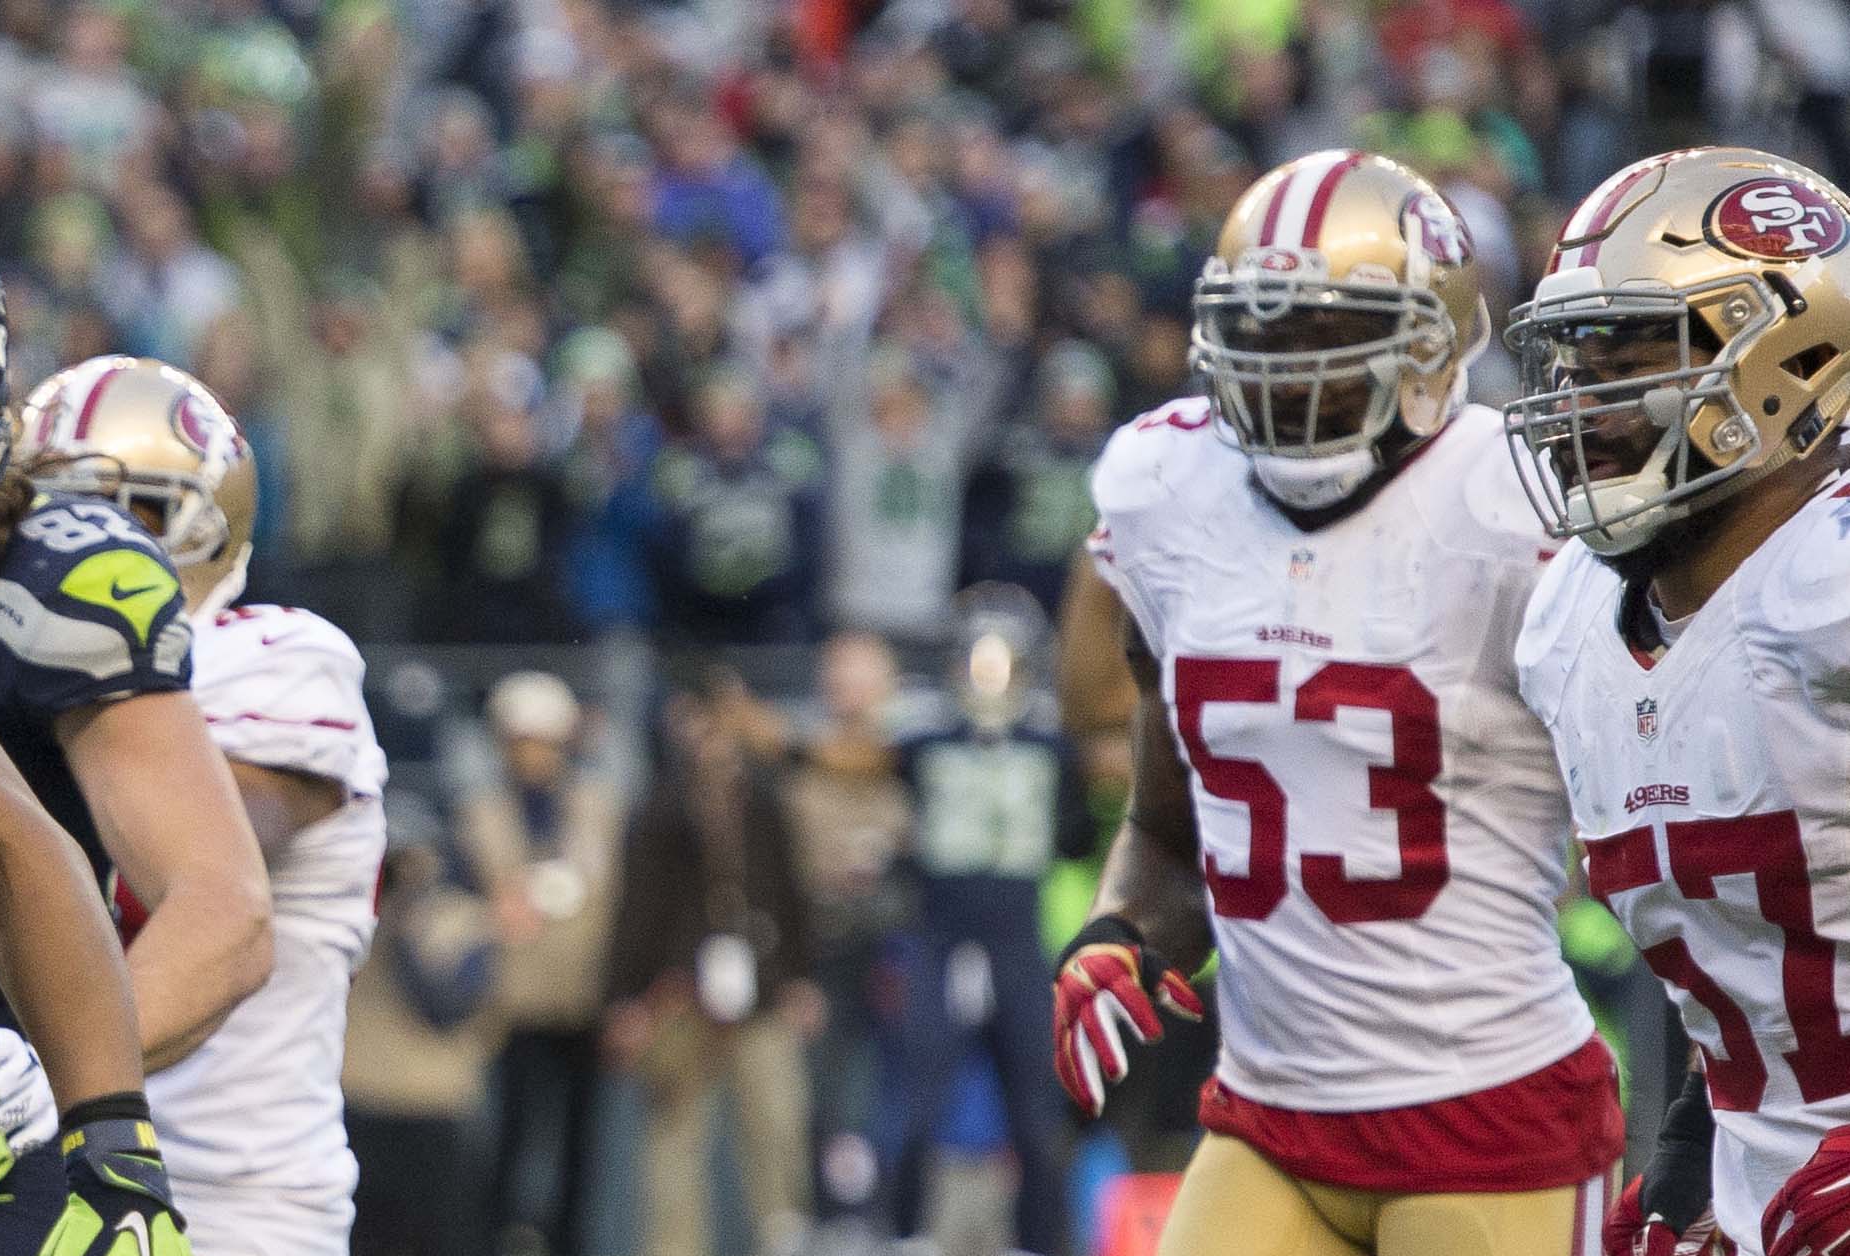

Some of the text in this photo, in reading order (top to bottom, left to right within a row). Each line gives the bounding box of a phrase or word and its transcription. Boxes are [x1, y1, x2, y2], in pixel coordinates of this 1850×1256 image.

[1741, 185, 1832, 252] SF
[1175, 655, 1450, 923] 53
[1624, 784, 1690, 815] 49ERS
[1584, 809, 1850, 1113] 57
